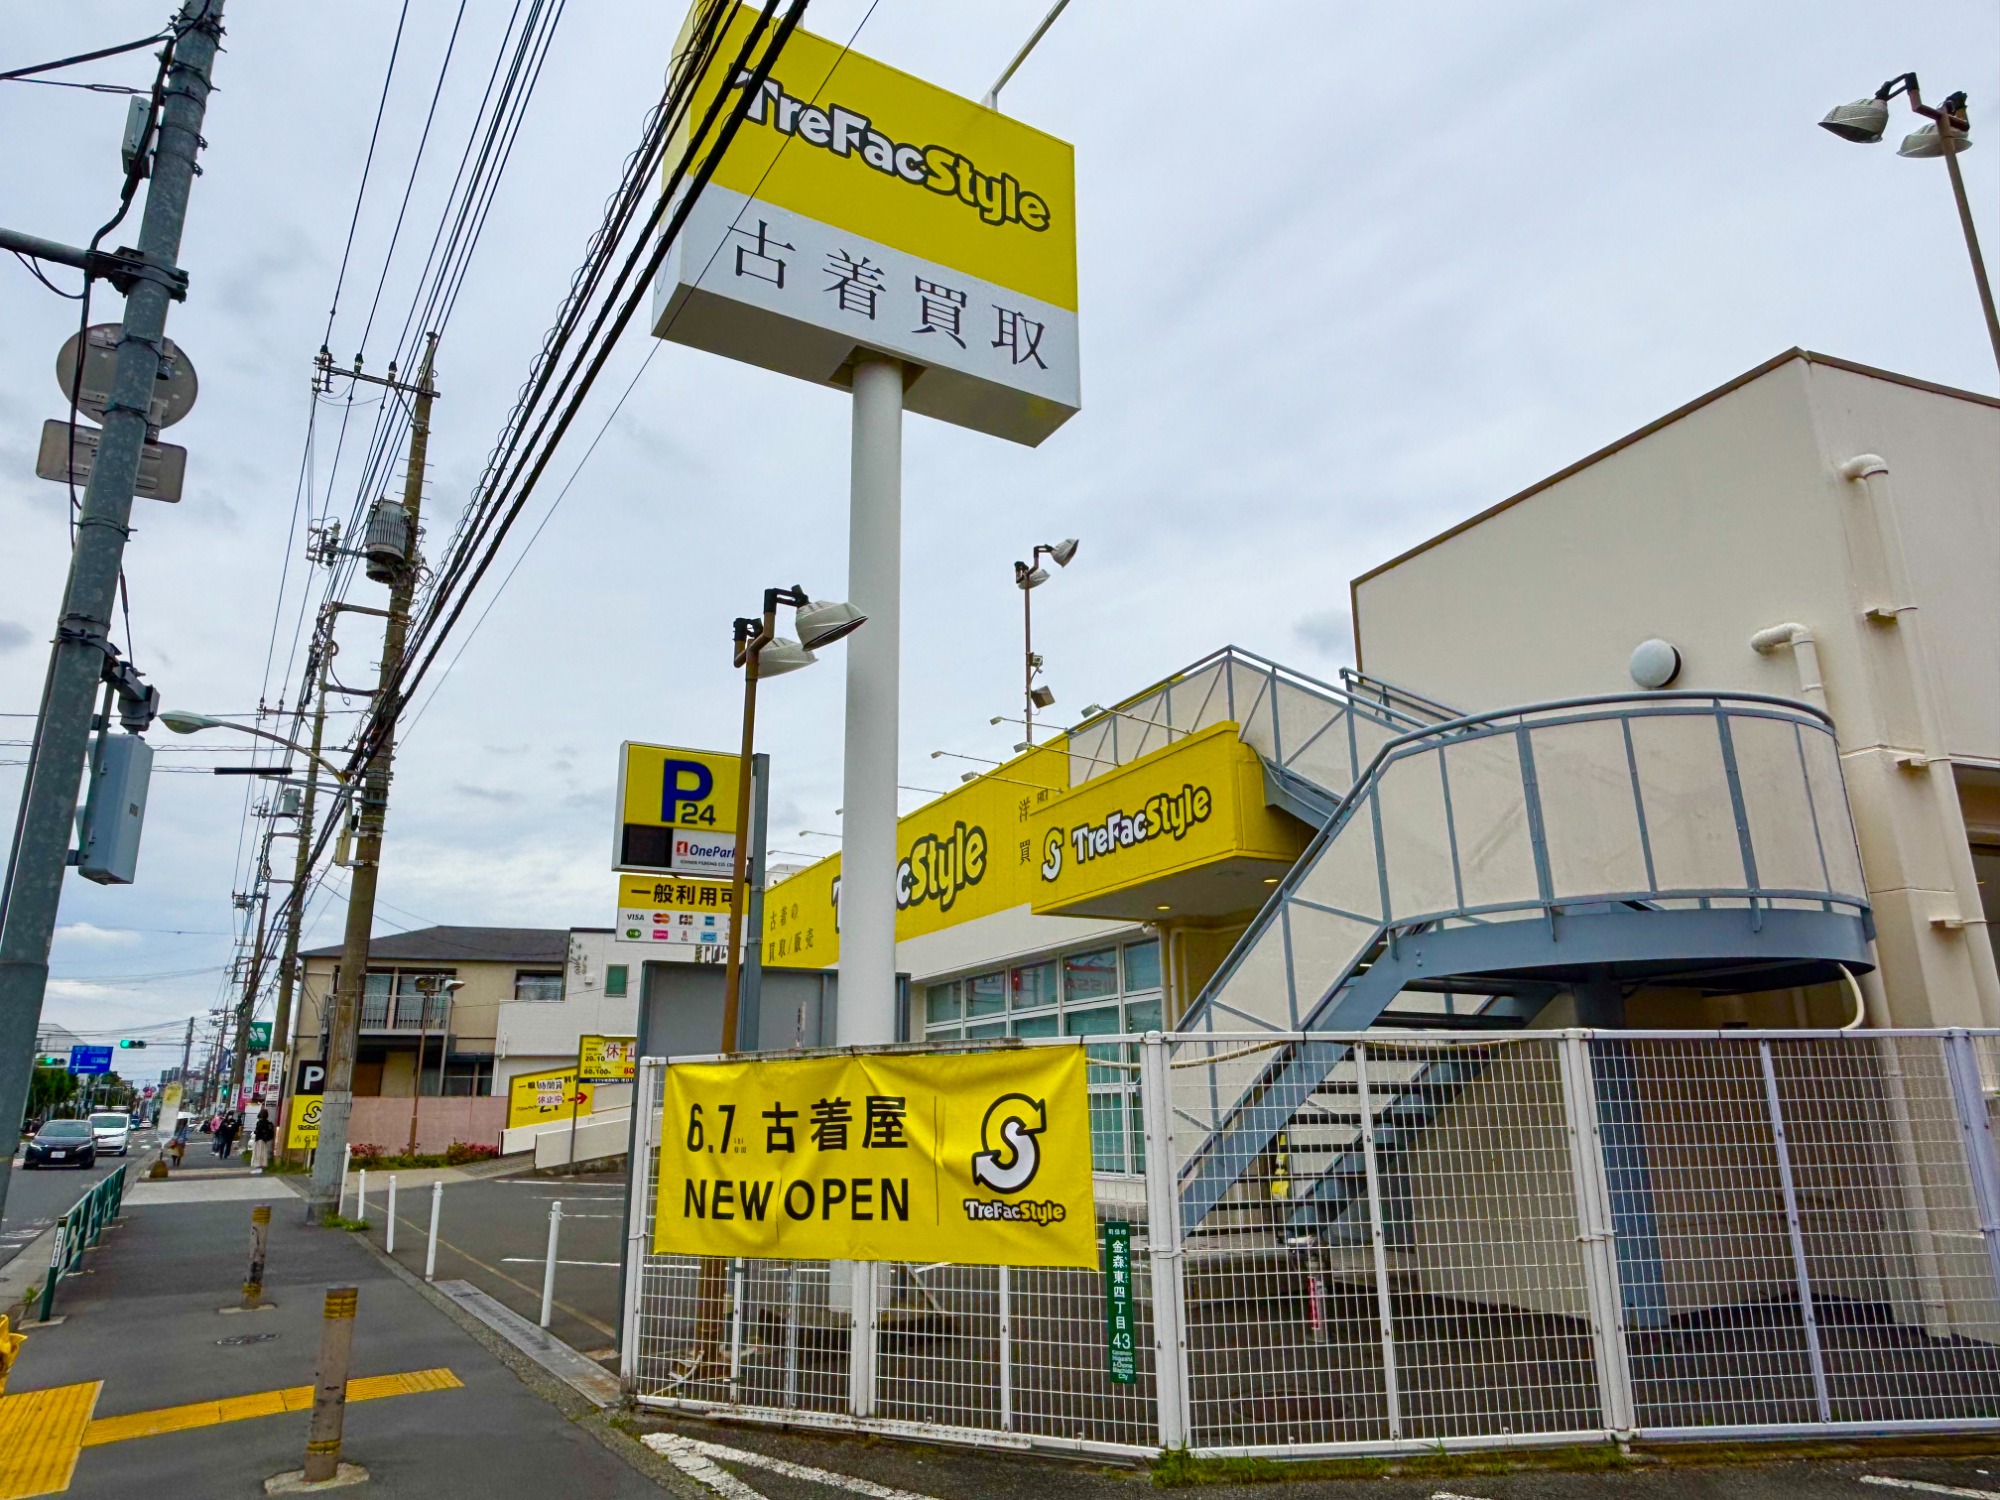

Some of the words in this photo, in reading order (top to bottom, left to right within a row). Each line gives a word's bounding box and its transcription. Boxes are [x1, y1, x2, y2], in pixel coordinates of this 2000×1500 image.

[727, 219, 1048, 370] 古着買取
[661, 759, 713, 823] P
[681, 803, 715, 826] 24
[631, 883, 733, 908] 一般利用可
[627, 913, 645, 922] VISA
[303, 1066, 325, 1090] P
[687, 1103, 736, 1155] 6.7
[762, 1096, 908, 1154] 古着屋
[684, 1179, 773, 1221] NEW
[784, 1178, 909, 1221] OPEN
[962, 1198, 1066, 1227] TreFacStyle
[1112, 1240, 1125, 1329] 金森東四丁目
[1113, 1333, 1131, 1349] 43
